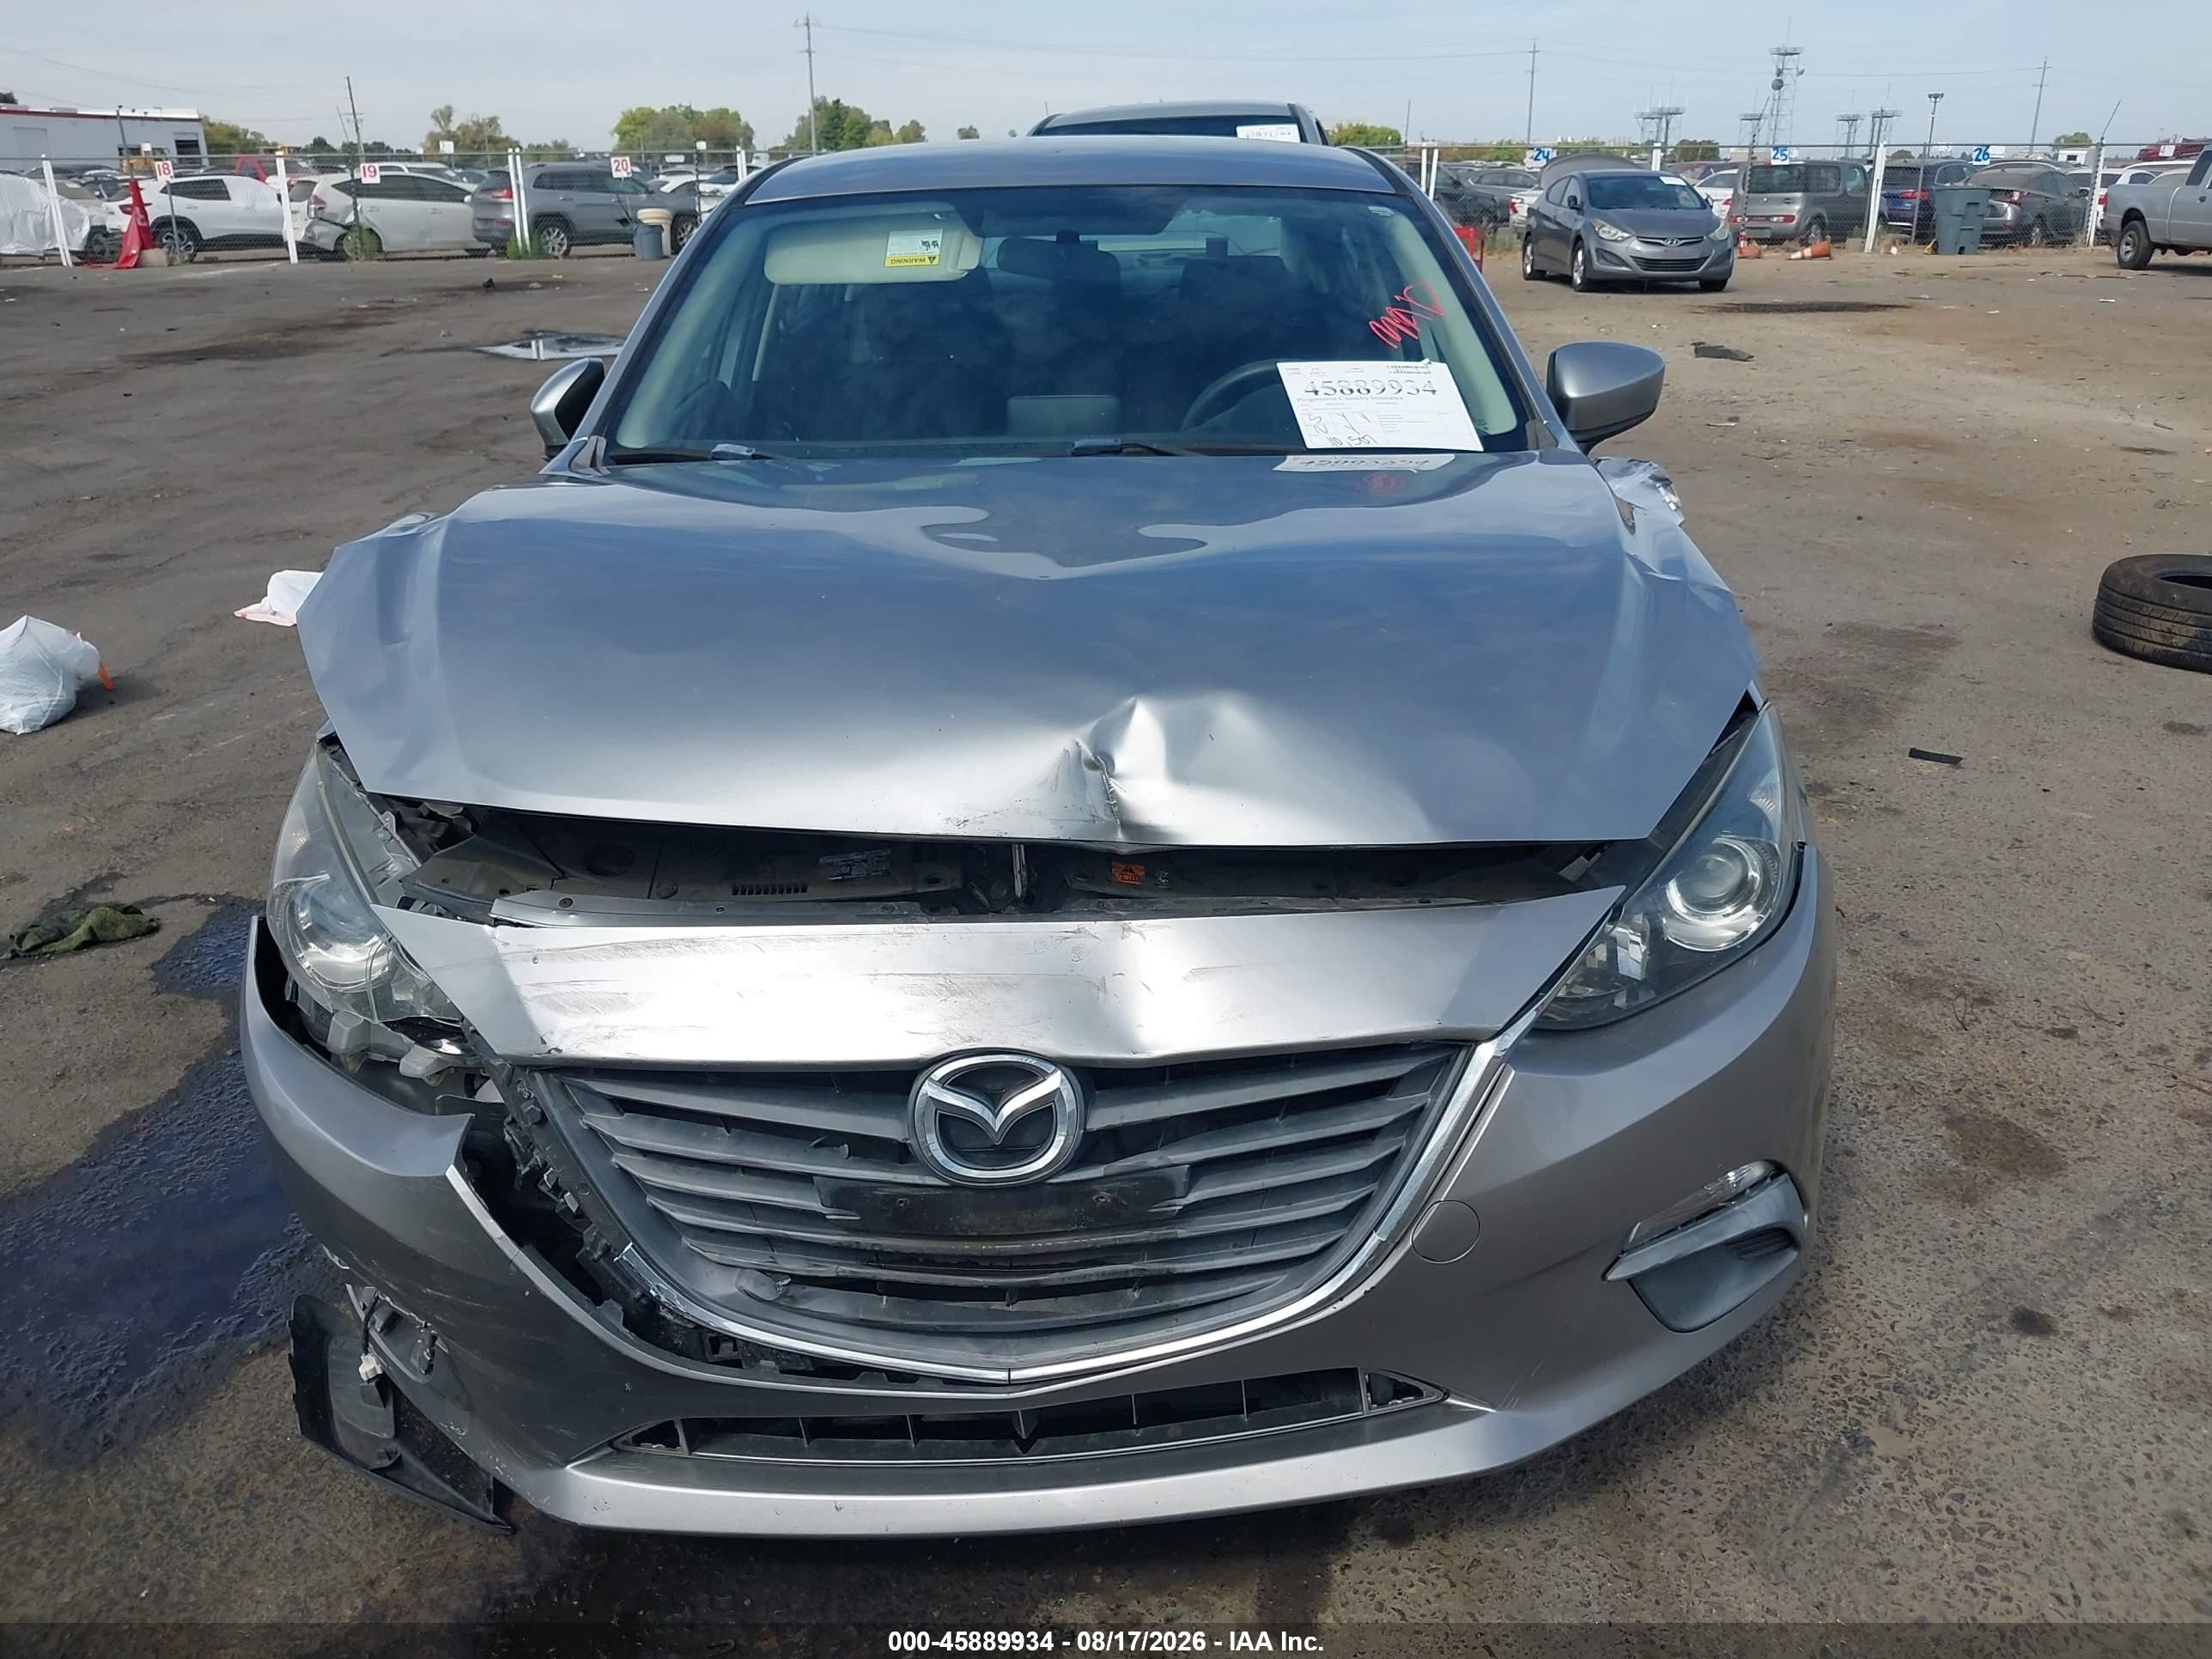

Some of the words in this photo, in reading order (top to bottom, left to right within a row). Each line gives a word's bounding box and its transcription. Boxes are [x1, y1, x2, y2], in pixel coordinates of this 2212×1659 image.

[1534, 148, 1551, 166] 24
[1771, 146, 1788, 161] 25
[1973, 145, 1990, 161] 26
[157, 162, 171, 177] 18
[362, 165, 377, 178] 19
[614, 159, 629, 172] 20
[890, 257, 926, 265] WARNING
[1305, 380, 1437, 396] 45889934
